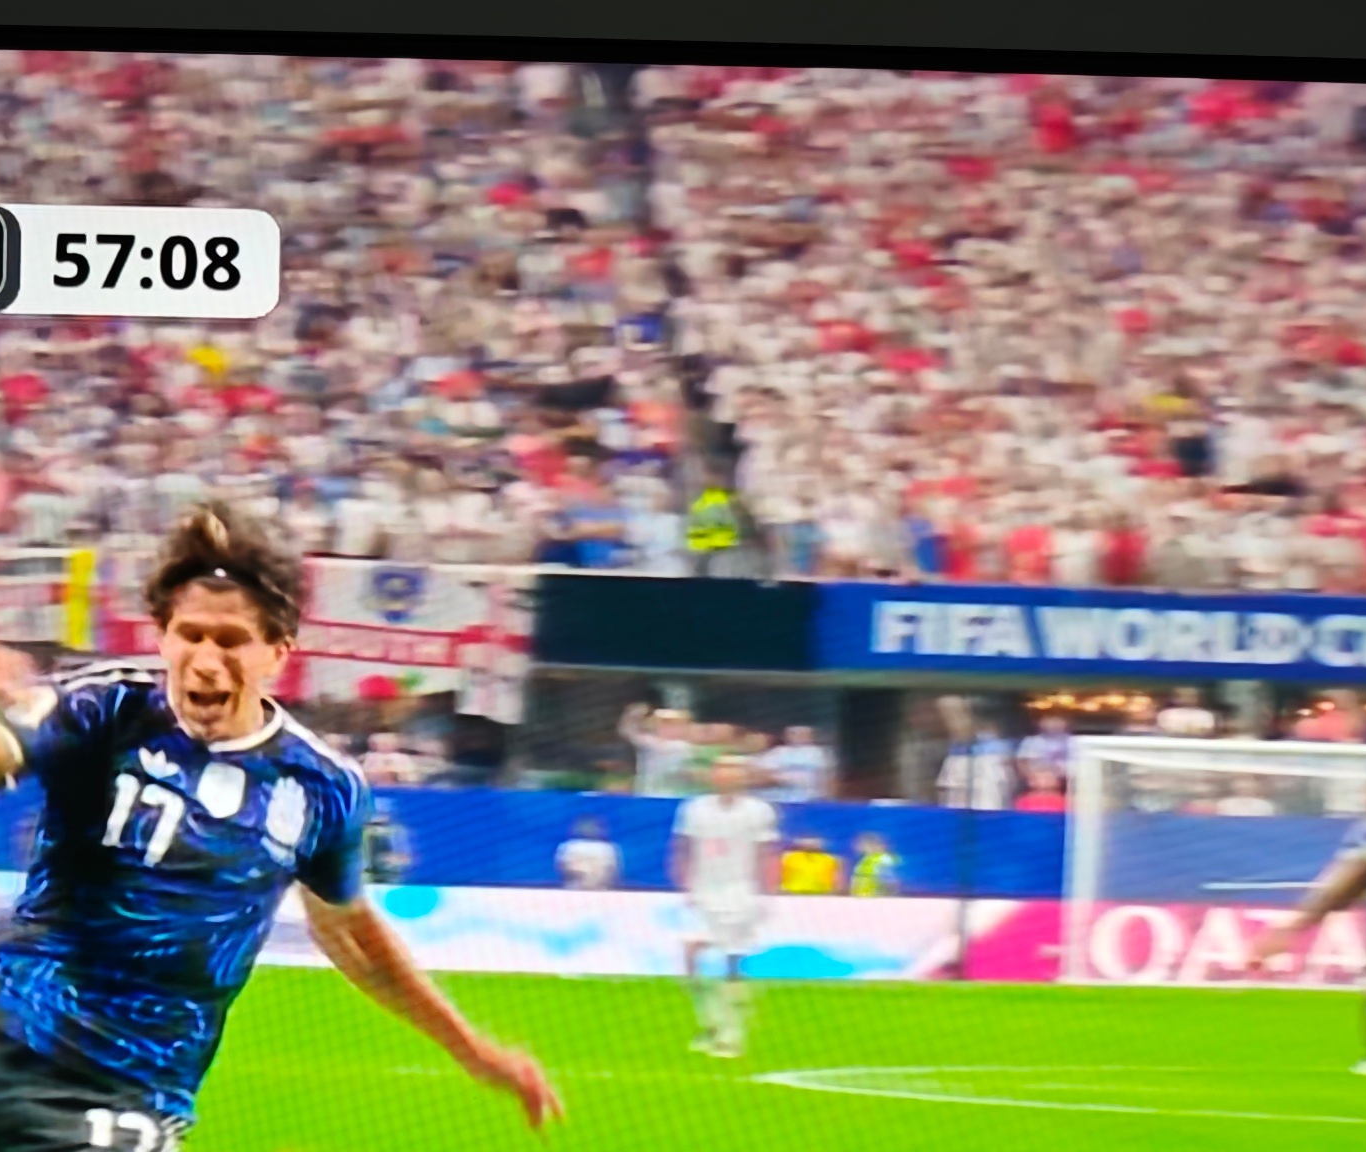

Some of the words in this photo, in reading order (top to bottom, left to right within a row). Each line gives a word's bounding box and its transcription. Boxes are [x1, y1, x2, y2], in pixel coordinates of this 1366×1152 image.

[53, 233, 241, 291] 57:08
[871, 601, 1037, 658] FIFA
[1037, 606, 1305, 664] WORLD
[102, 773, 185, 868] 17
